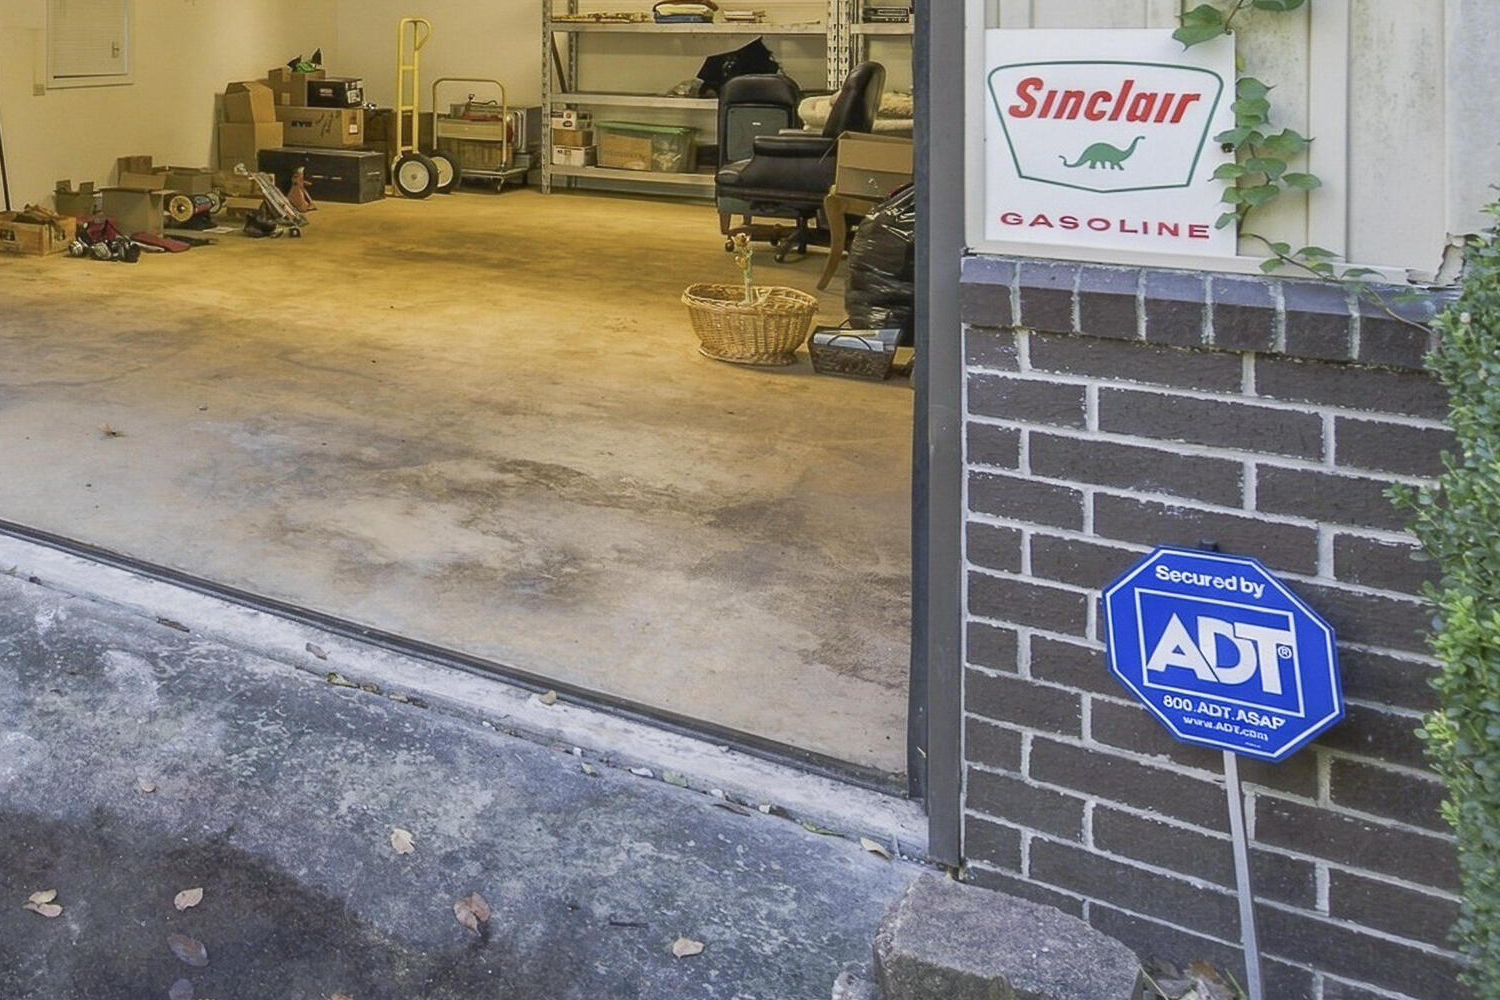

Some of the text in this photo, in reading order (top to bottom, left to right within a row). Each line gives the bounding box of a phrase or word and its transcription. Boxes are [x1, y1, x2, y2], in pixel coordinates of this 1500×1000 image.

[1007, 76, 1202, 124] Sinclair
[1000, 212, 1210, 239] GASOLINE
[1155, 565, 1265, 599] Secured by
[1163, 694, 1286, 730] 800.ADT.ASAP
[1183, 716, 1268, 741] www.ADT.com
